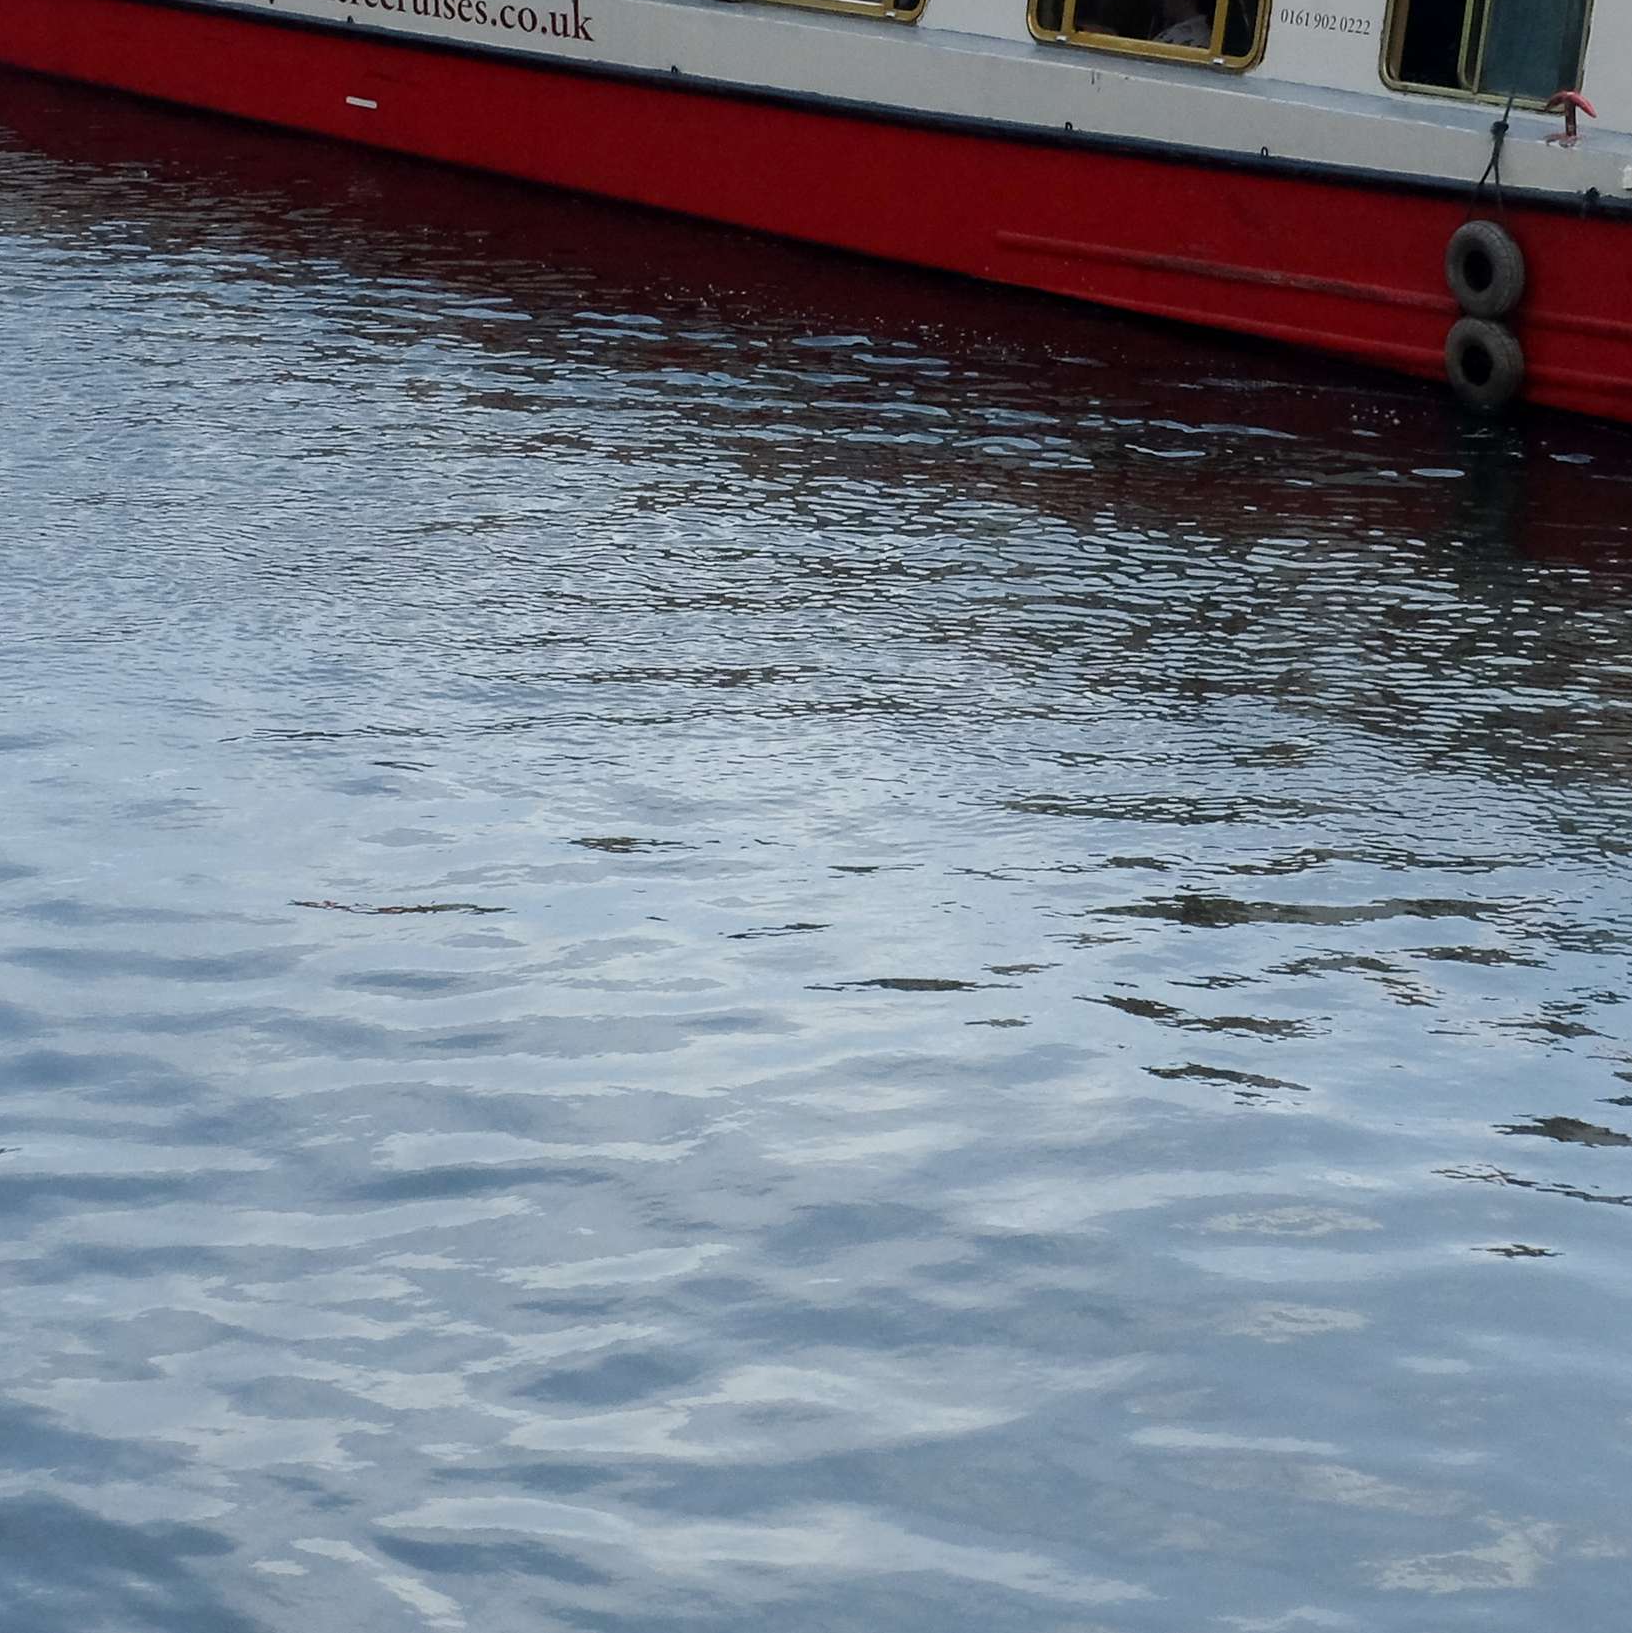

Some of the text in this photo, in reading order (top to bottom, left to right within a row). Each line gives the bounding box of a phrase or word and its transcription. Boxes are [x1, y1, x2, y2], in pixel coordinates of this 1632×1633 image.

[1280, 8, 1371, 35] 0161 902 0222
